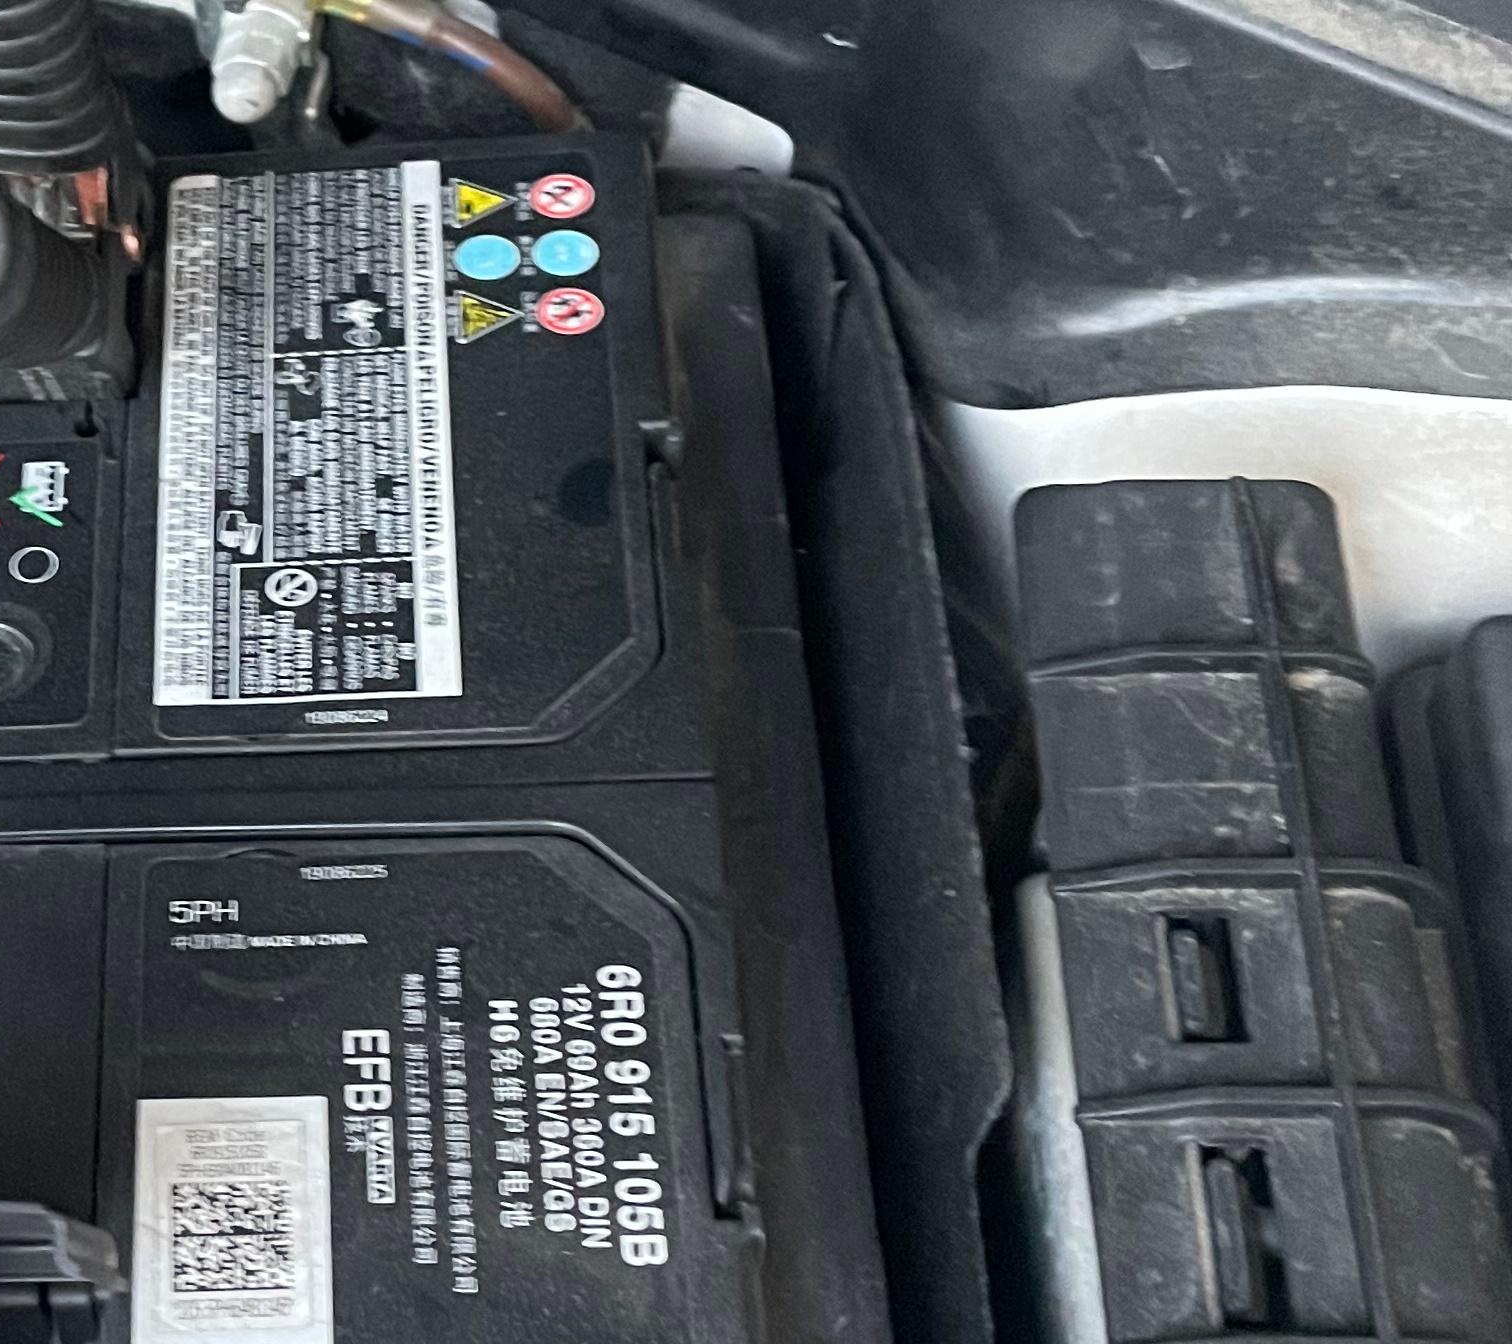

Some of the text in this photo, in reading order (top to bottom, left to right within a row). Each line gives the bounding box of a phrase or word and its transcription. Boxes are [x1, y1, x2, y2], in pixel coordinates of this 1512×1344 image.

[168, 899, 239, 924] 5PH
[562, 983, 596, 1032] 12V
[342, 1029, 393, 1111] EFB
[596, 965, 669, 1266] 6R0 915 105B
[578, 1197, 613, 1248] DIN
